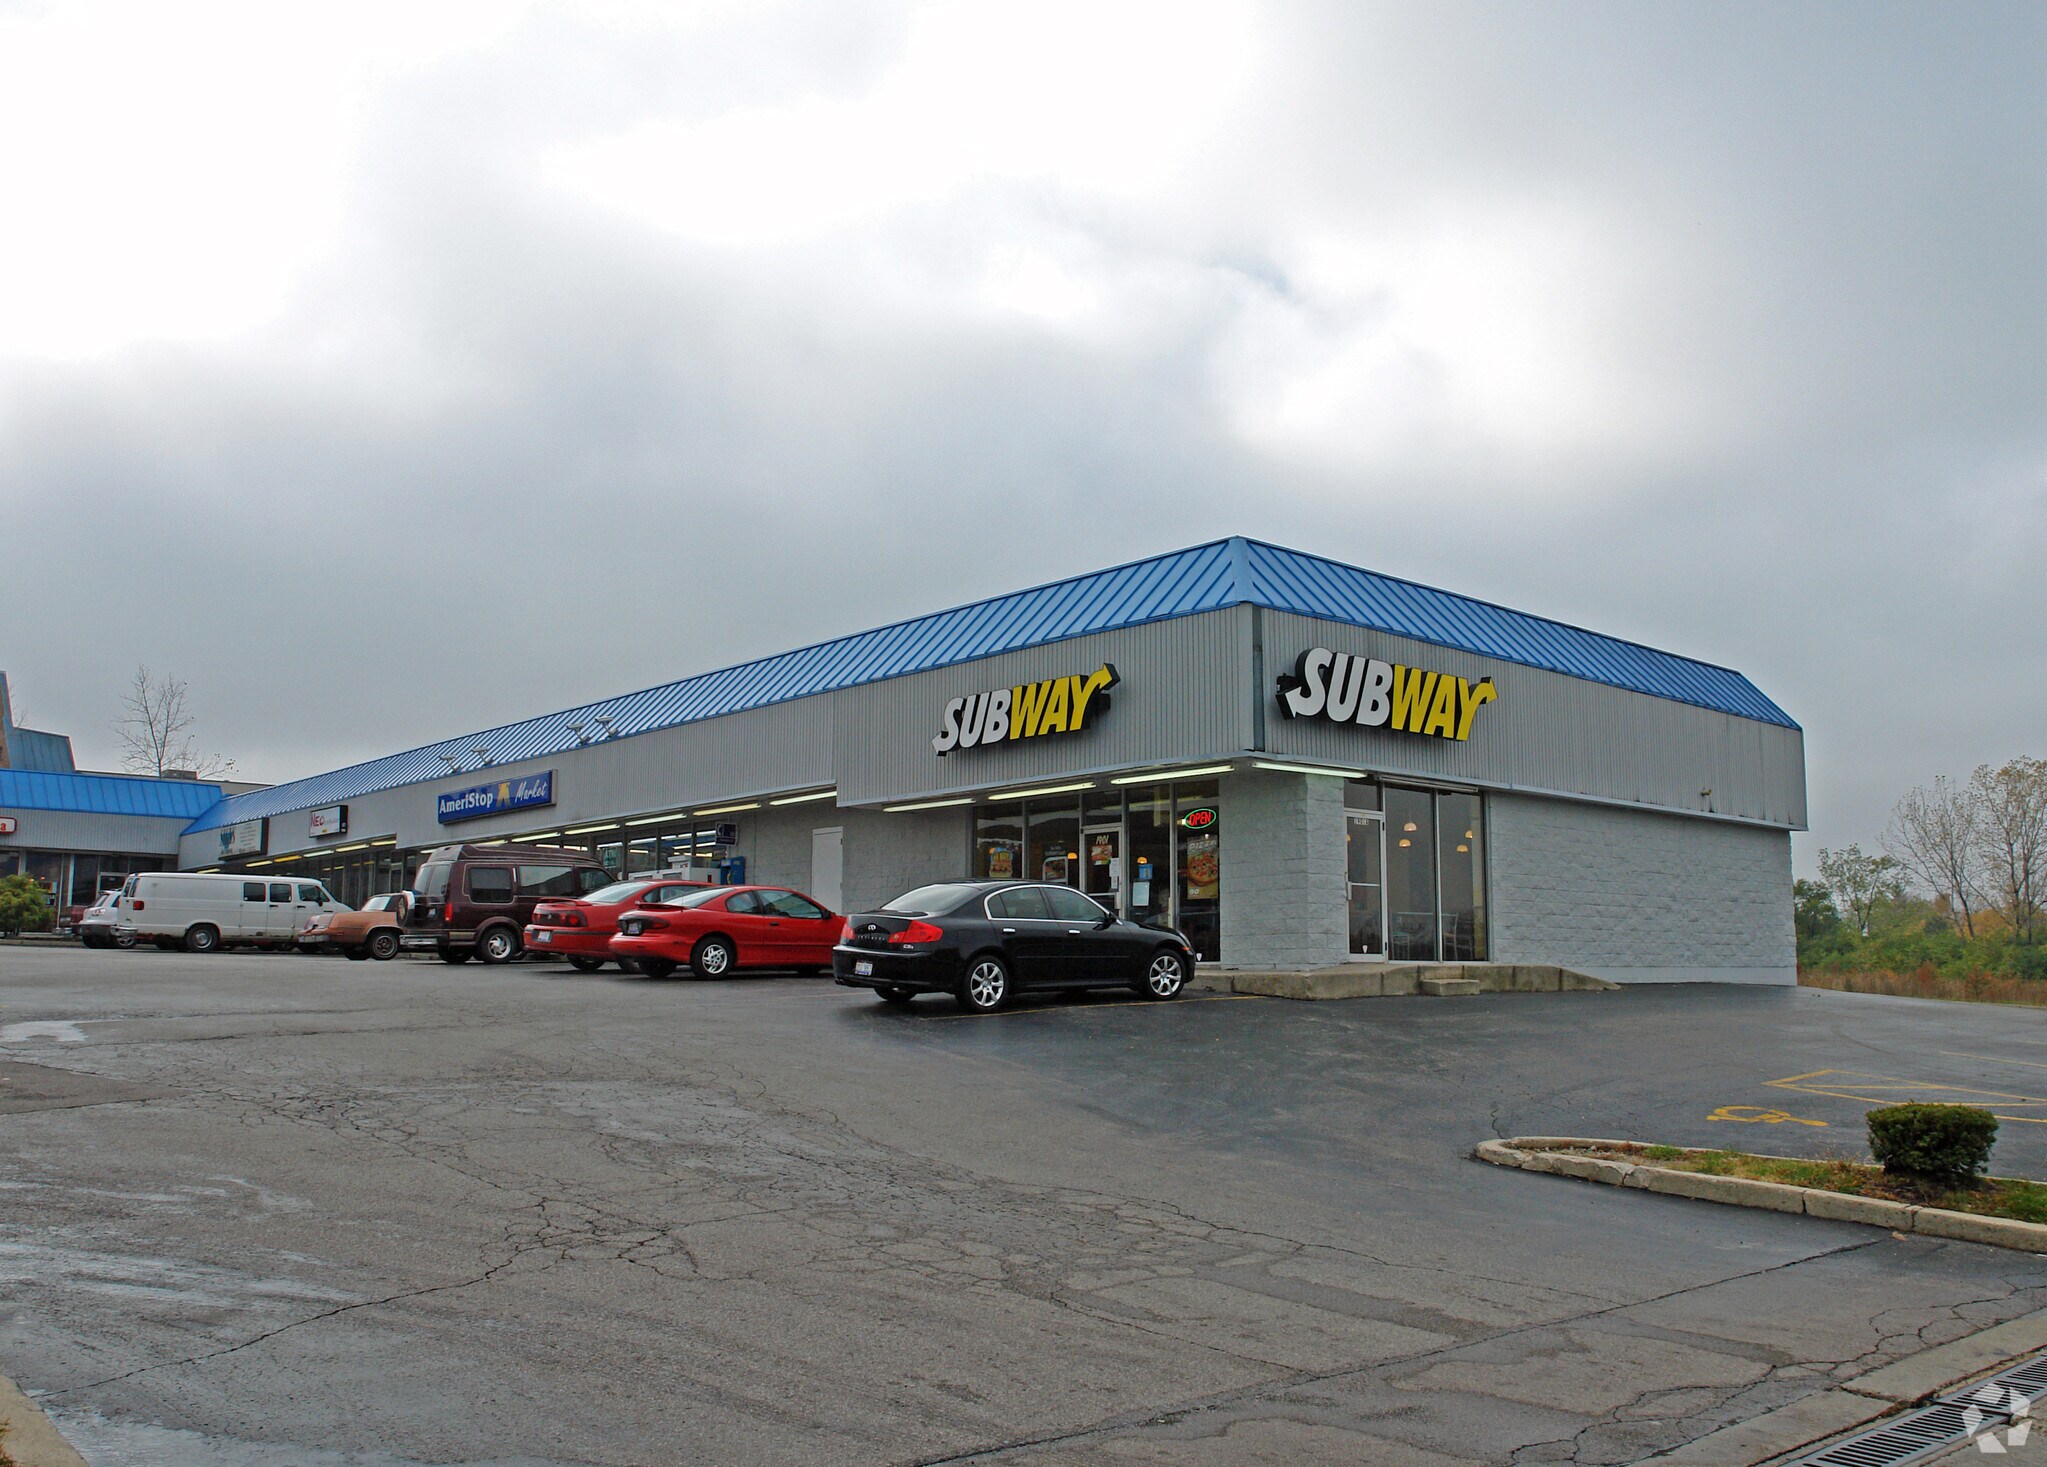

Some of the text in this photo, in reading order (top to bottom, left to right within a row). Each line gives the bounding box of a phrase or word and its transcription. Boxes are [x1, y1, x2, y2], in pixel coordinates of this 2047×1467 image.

[931, 662, 1116, 756] SUBWAY
[1279, 647, 1498, 742] SUBWAY
[438, 779, 548, 814] AmeriStop Market
[1189, 811, 1212, 827] OPEN
